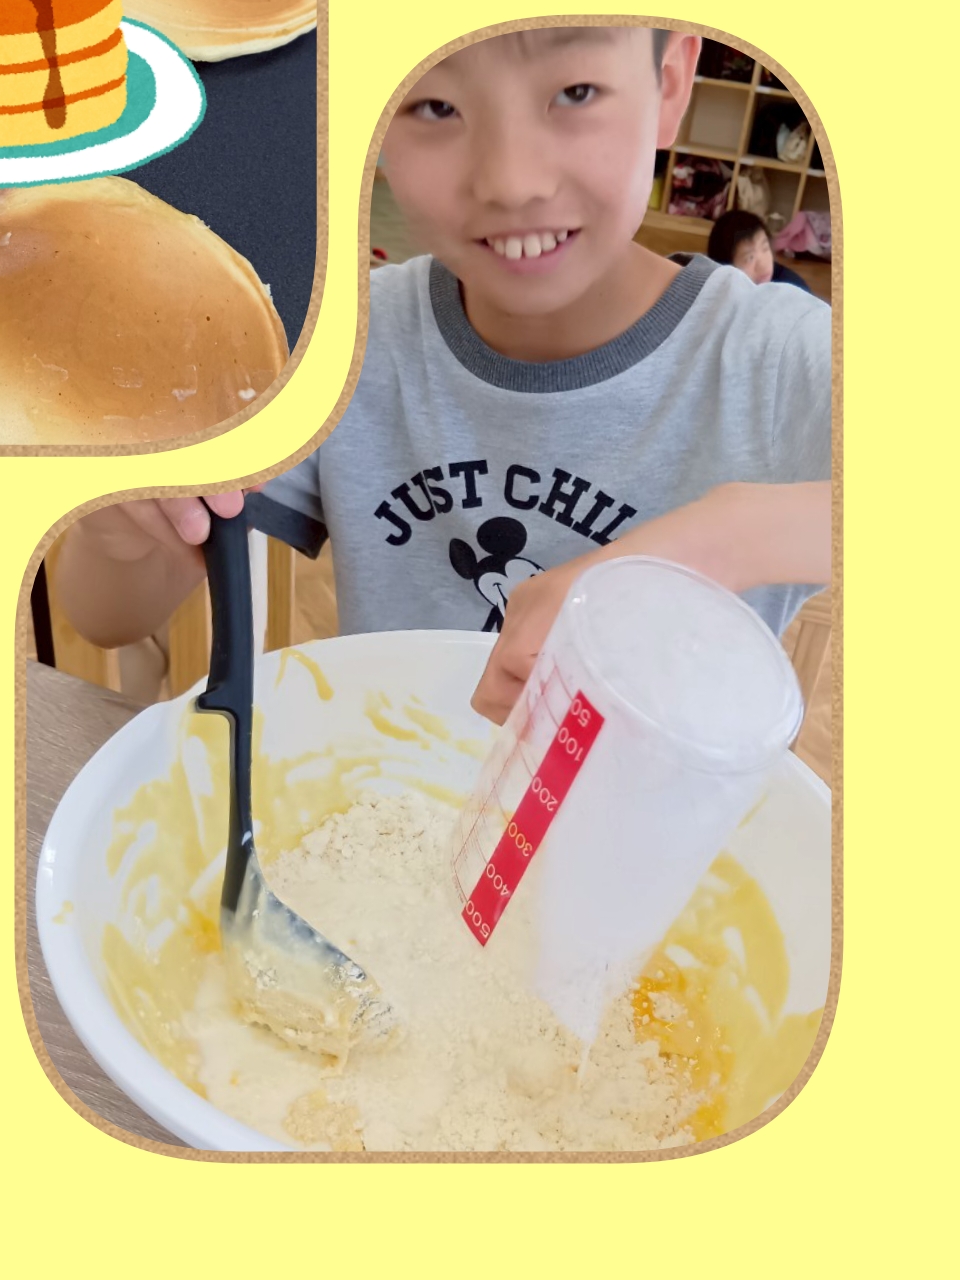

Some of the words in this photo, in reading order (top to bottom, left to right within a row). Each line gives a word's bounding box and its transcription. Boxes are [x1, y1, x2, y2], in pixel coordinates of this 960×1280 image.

[374, 459, 488, 546] JUST
[570, 698, 591, 728] 50
[557, 726, 584, 762] 100
[531, 776, 559, 812] 200
[508, 821, 533, 857] 300
[486, 863, 510, 896] 400
[466, 900, 490, 939] 500
